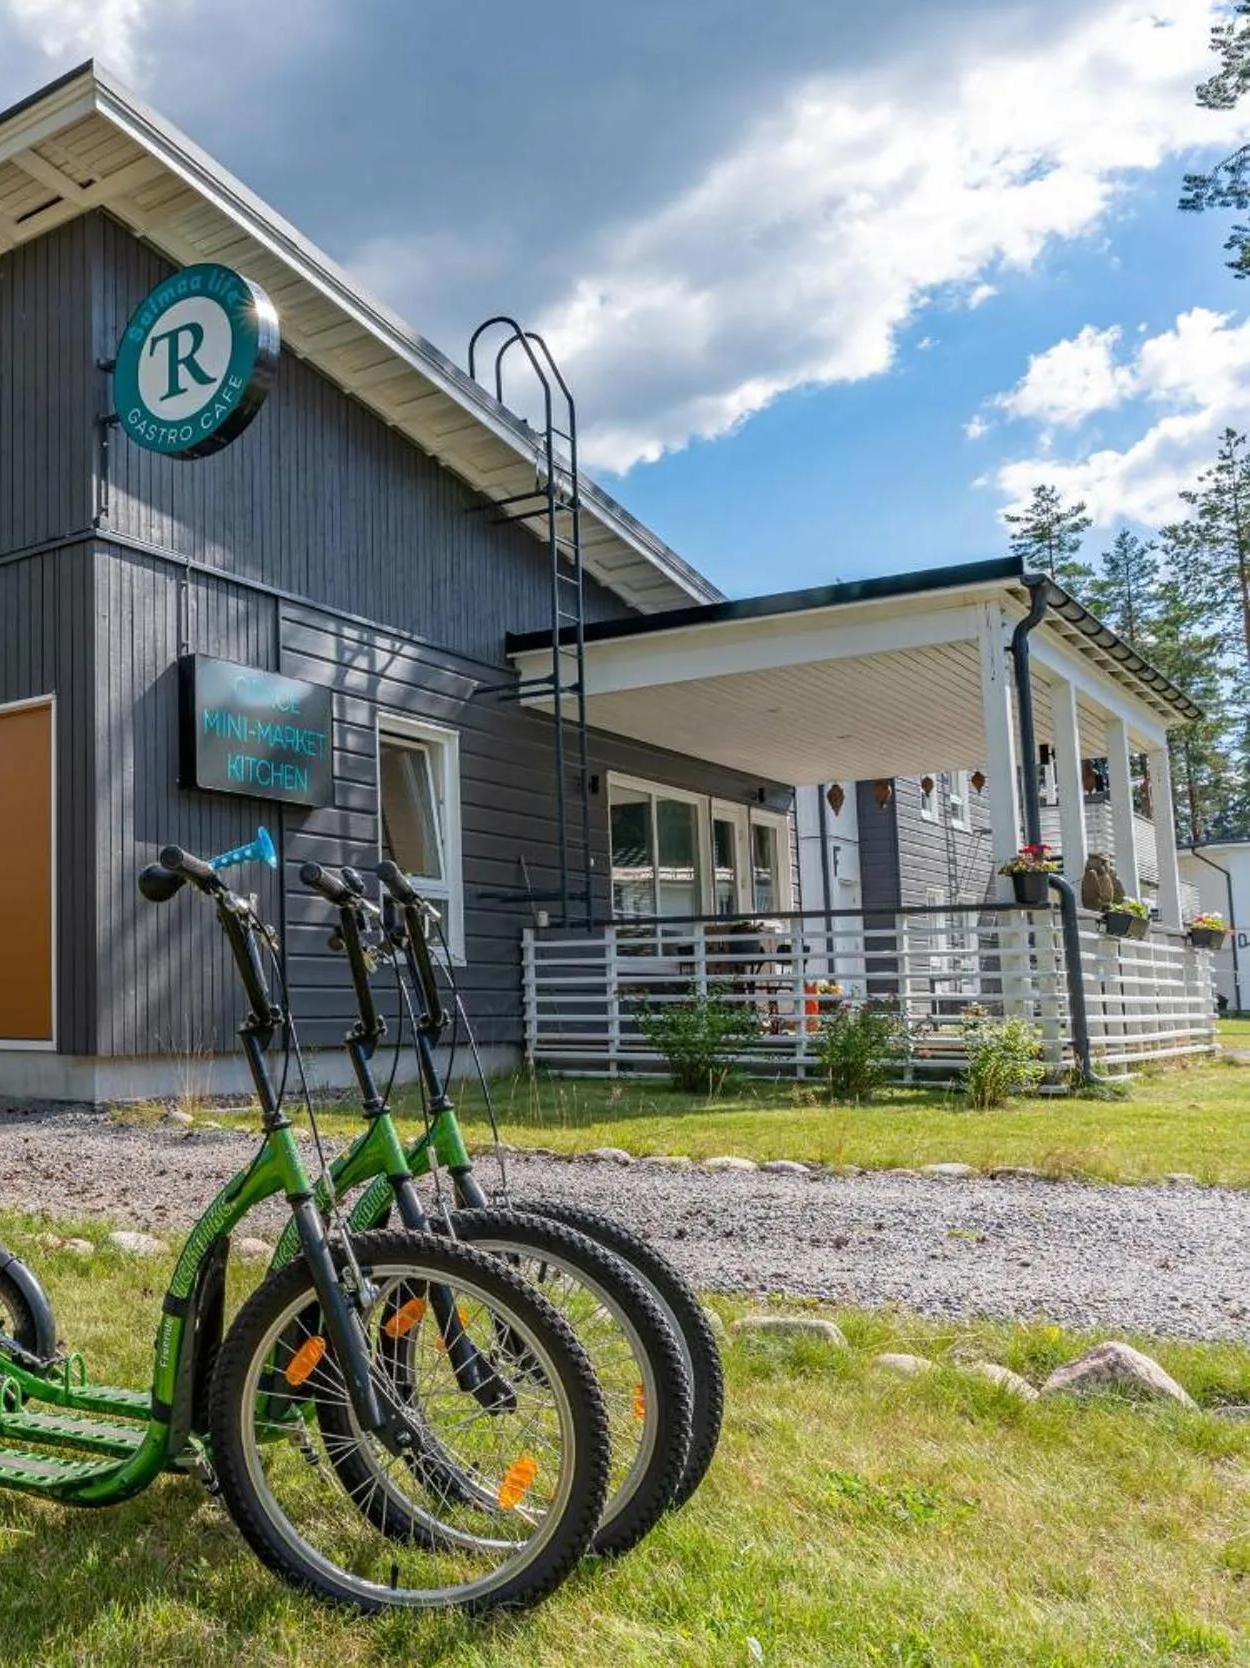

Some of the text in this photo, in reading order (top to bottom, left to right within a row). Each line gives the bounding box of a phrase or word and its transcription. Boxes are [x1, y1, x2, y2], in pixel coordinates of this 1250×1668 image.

[129, 274, 201, 342] Saimaa
[149, 321, 217, 402] R
[127, 374, 243, 443] GASTRO CAFE
[203, 707, 326, 761] MINI-MARKET
[226, 753, 308, 792] KITCHEN
